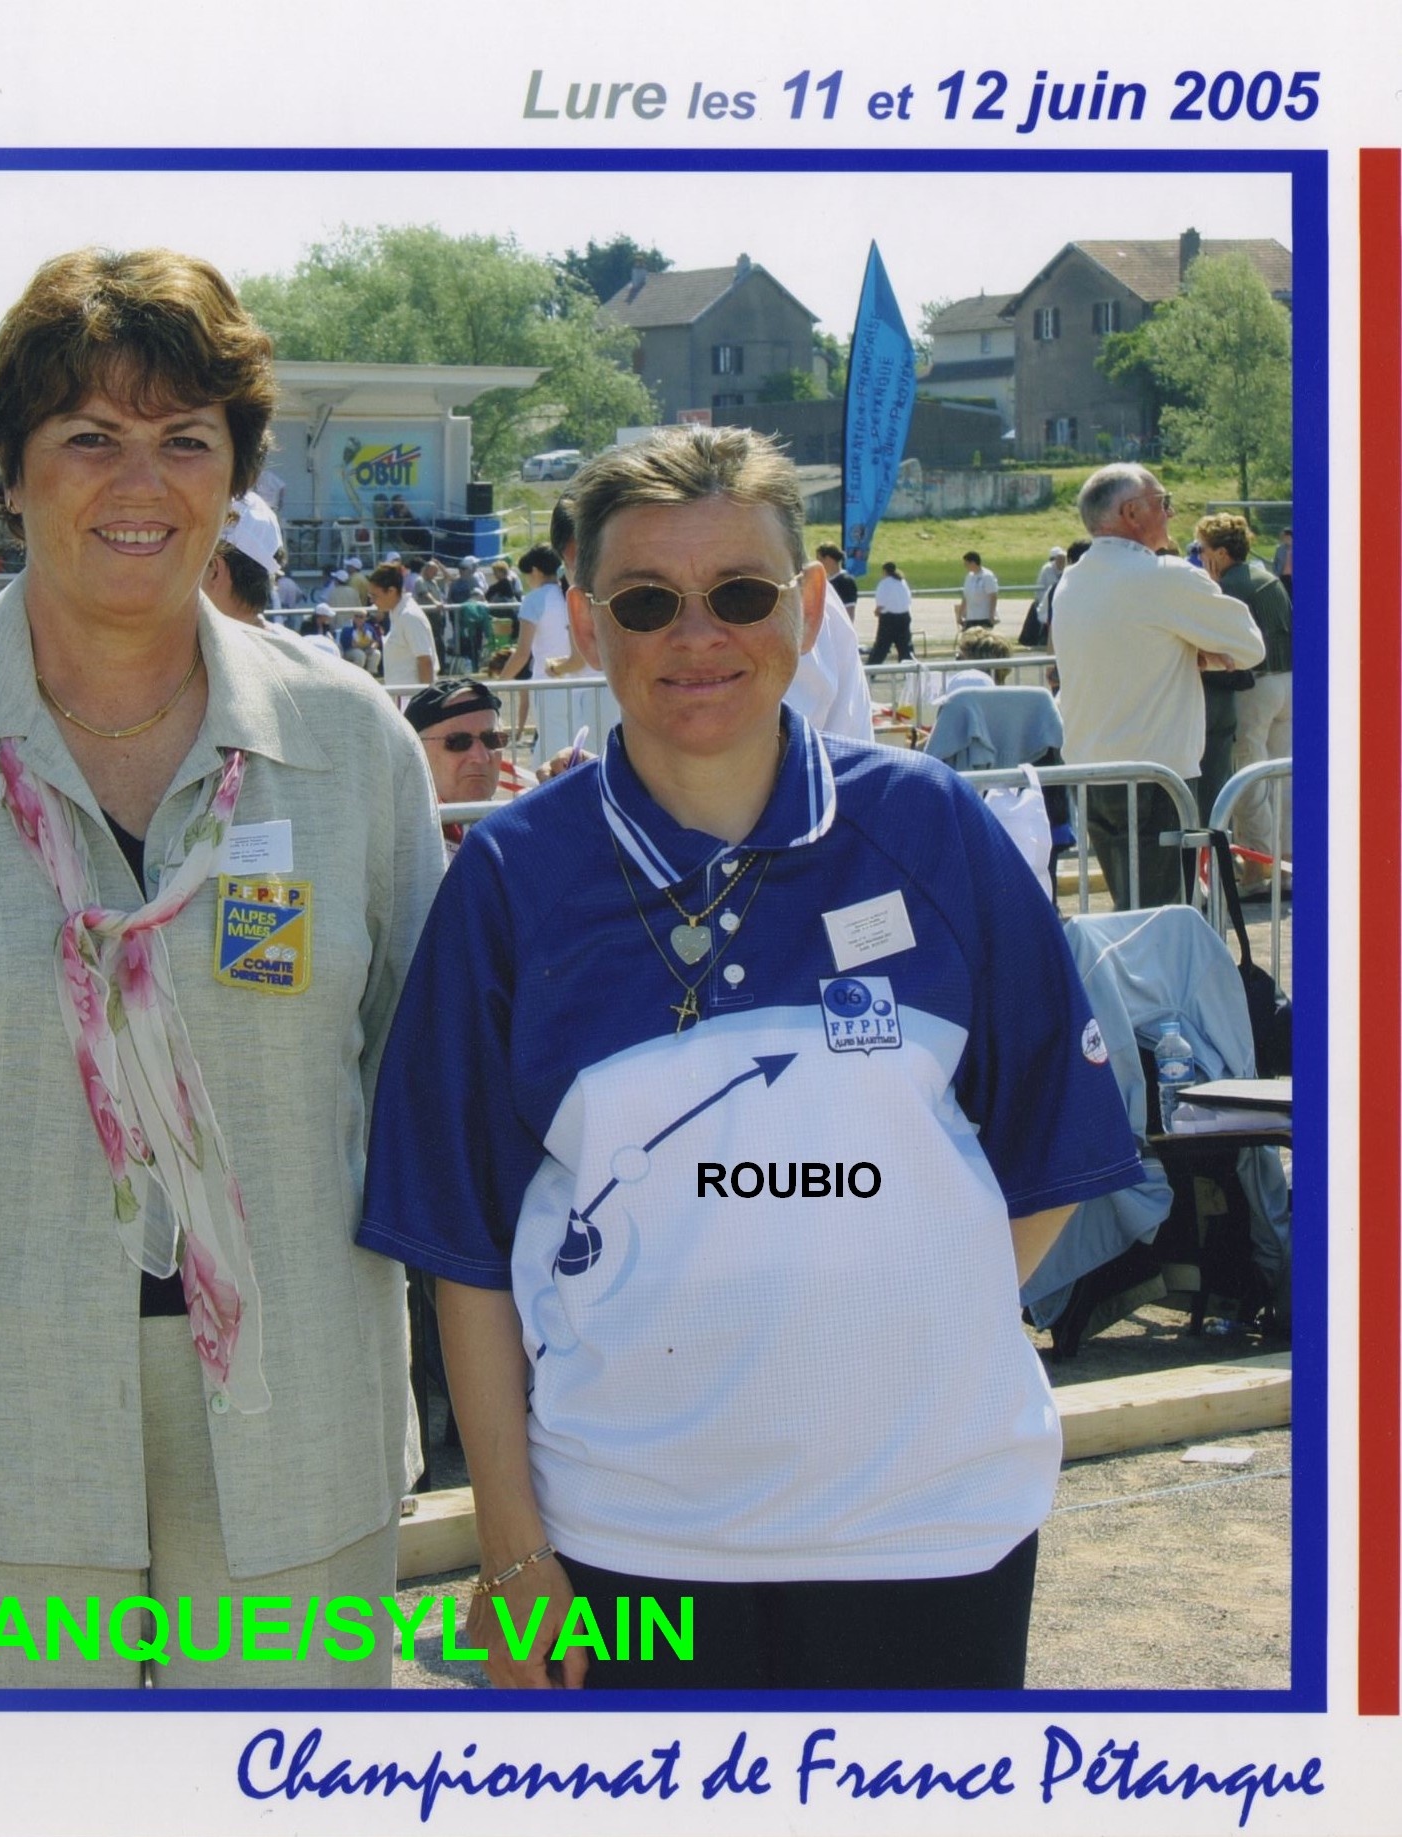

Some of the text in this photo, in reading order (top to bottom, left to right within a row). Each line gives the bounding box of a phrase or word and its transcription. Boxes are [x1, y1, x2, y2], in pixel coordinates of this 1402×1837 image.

[356, 461, 413, 486] OBUT
[227, 907, 277, 926] ALPES
[230, 968, 294, 986] DIRECTEUR
[834, 988, 862, 1005] 06
